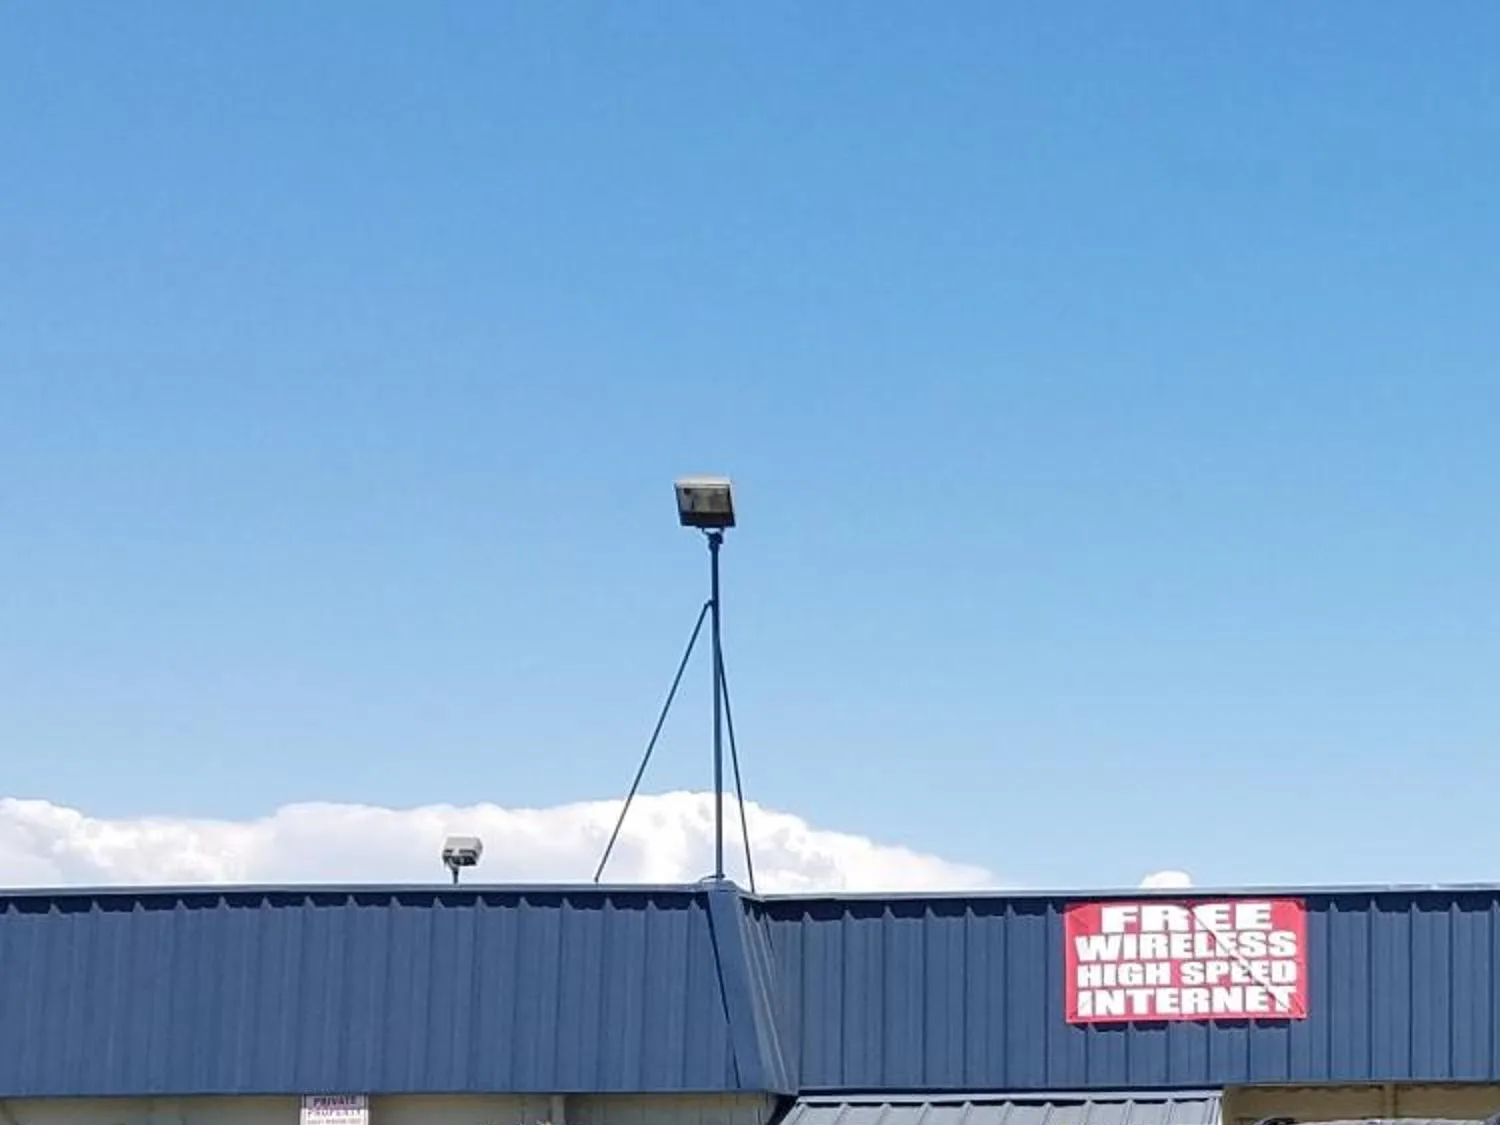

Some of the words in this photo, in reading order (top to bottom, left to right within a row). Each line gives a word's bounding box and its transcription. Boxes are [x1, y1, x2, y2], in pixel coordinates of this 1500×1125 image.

[1100, 902, 1273, 934] FREE
[1075, 930, 1297, 962] WIRELESS
[1076, 961, 1171, 988] HIGH
[1179, 959, 1297, 985] SPEED
[1077, 985, 1297, 1017] INTERNET
